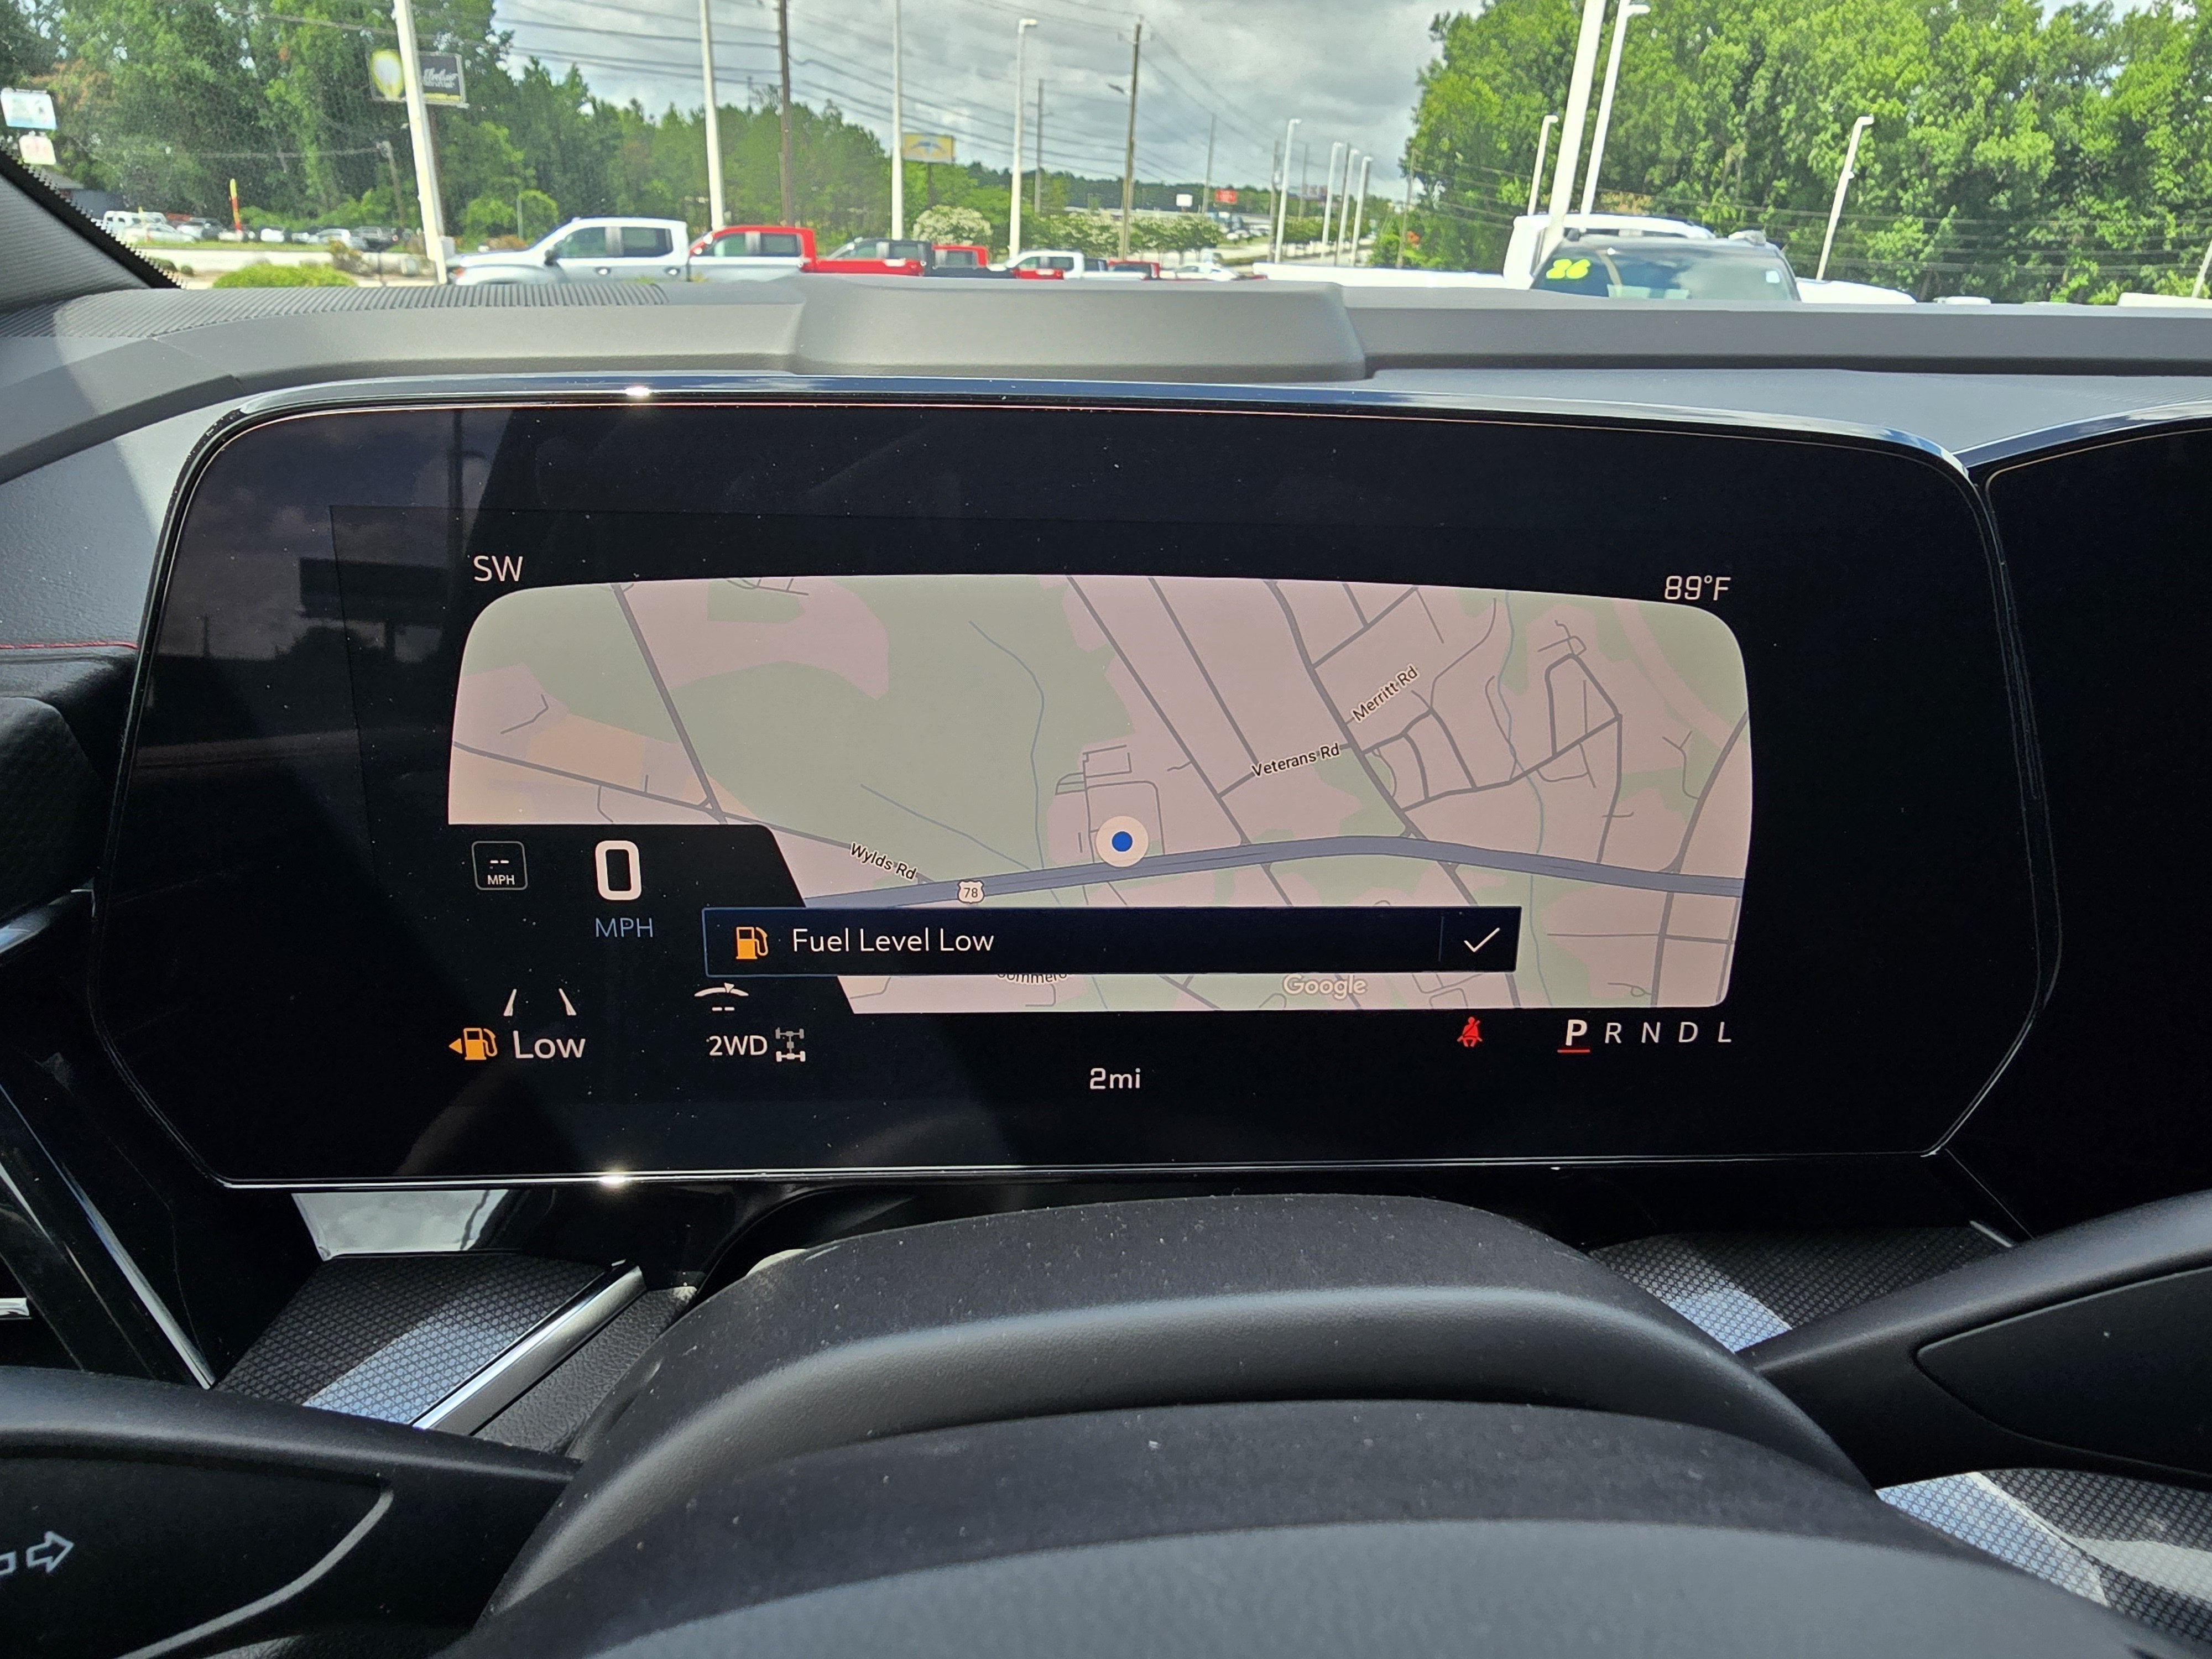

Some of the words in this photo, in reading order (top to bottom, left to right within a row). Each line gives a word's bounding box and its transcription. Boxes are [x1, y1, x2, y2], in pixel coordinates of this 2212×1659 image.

[473, 555, 523, 582] SW
[1664, 575, 1731, 601] 89°F
[1352, 681, 1399, 722] Merritt
[1396, 665, 1418, 686] Rd
[1251, 752, 1317, 776] Veterans
[1320, 743, 1340, 759] Rd
[595, 840, 642, 901] 0
[851, 842, 893, 870] Wylds
[895, 862, 917, 880] Rd
[487, 874, 515, 885] MPH
[963, 887, 978, 898] 78
[595, 917, 654, 938] MPH
[793, 927, 849, 952] Fuel
[859, 927, 930, 952] Level
[940, 927, 995, 952] Low
[1282, 973, 1368, 1000] Google
[513, 1030, 586, 1060] Low
[709, 1034, 768, 1056] 2WD
[1565, 1019, 1588, 1046] P
[1604, 1022, 1623, 1044] R
[1641, 1021, 1661, 1044] N
[1678, 1021, 1699, 1043] D
[1717, 1021, 1732, 1043] L
[1089, 1067, 1141, 1090] 2mi
